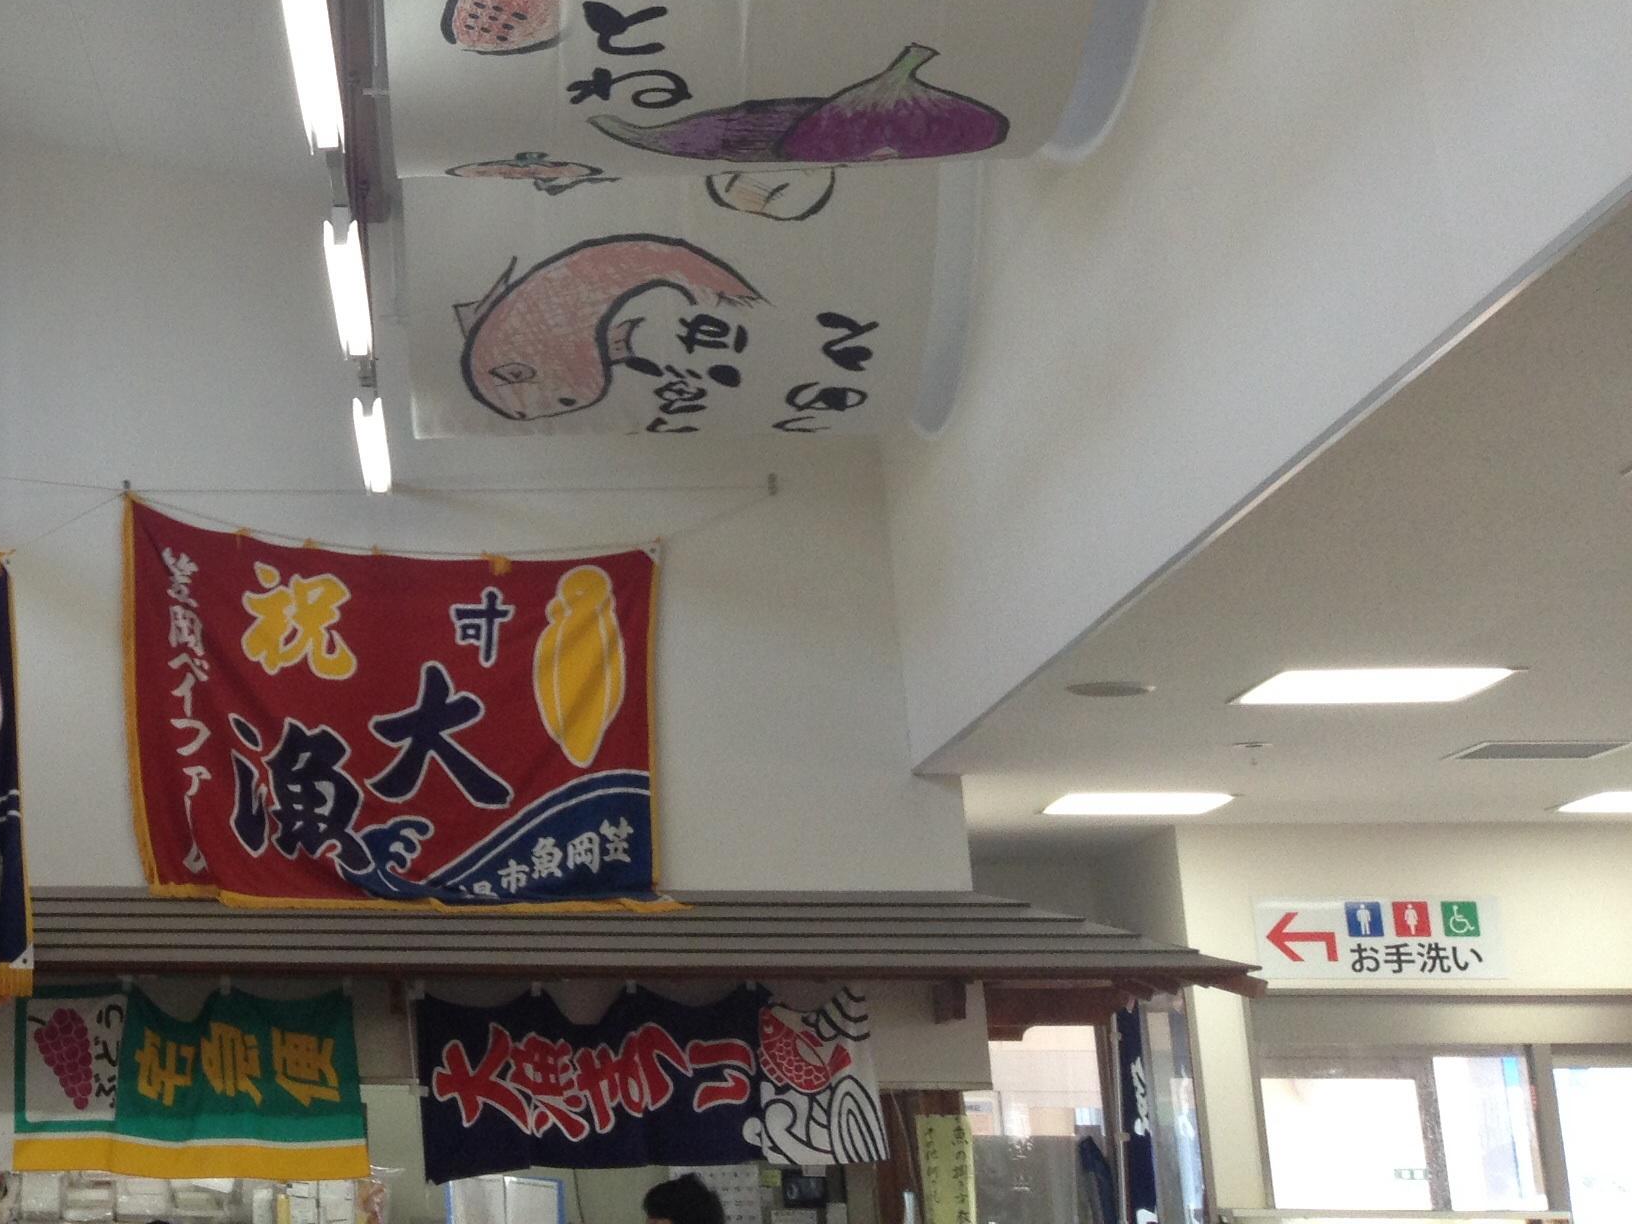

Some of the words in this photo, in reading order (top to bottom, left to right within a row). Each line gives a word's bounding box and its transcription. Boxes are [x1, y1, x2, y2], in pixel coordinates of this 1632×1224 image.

[241, 561, 358, 680] 祝
[1350, 943, 1484, 975] お手洗い
[134, 1021, 342, 1108] 宅急便
[432, 1022, 757, 1143] 大漁まつり
